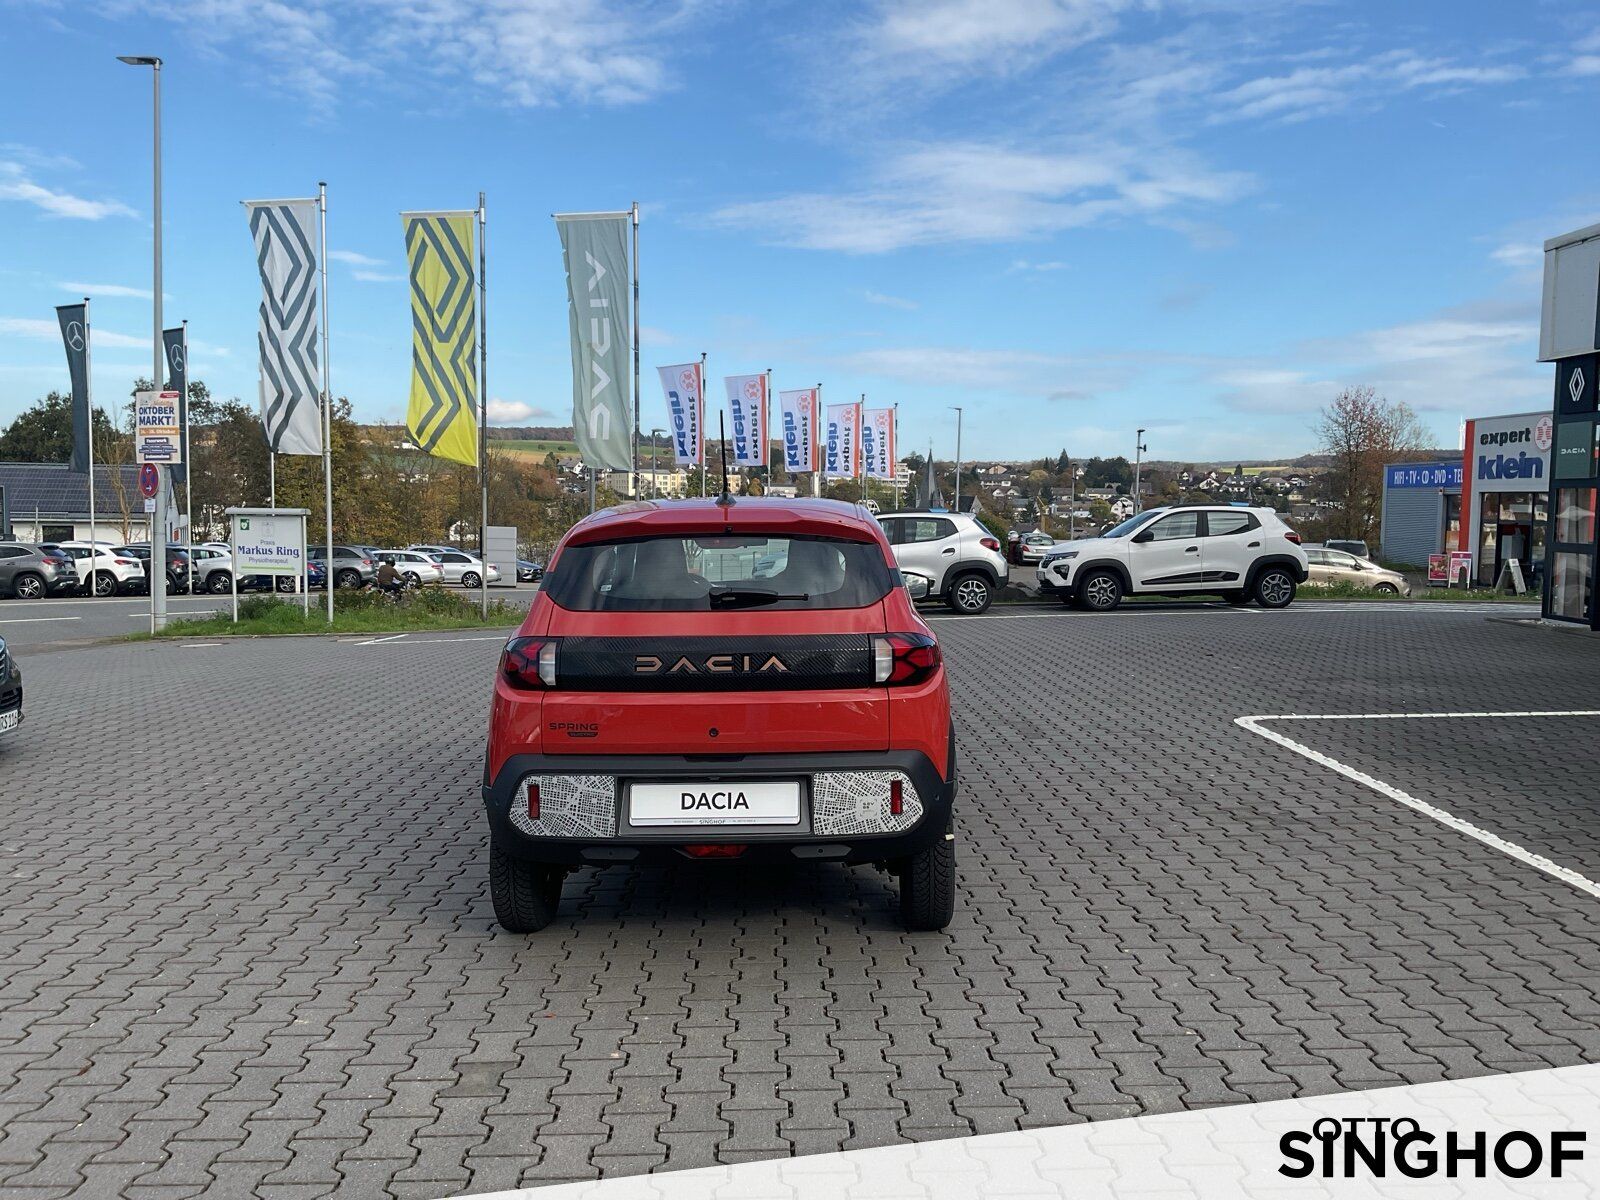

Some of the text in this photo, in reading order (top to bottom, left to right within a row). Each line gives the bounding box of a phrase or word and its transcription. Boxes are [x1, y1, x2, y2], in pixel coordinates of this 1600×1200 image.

[138, 406, 175, 415] OKTOBER
[138, 416, 172, 425] MARKT
[1480, 427, 1531, 446] expert
[1560, 447, 1586, 455] DACIA
[1478, 451, 1543, 480] klein
[1393, 470, 1405, 485] HIFI
[1408, 470, 1418, 485] TV
[1421, 470, 1429, 484] CD
[1434, 469, 1447, 484] DVD
[237, 545, 300, 558] Markus Ring
[634, 654, 792, 673] DACIA
[549, 722, 599, 730] SPRING
[681, 792, 749, 810] DACIA
